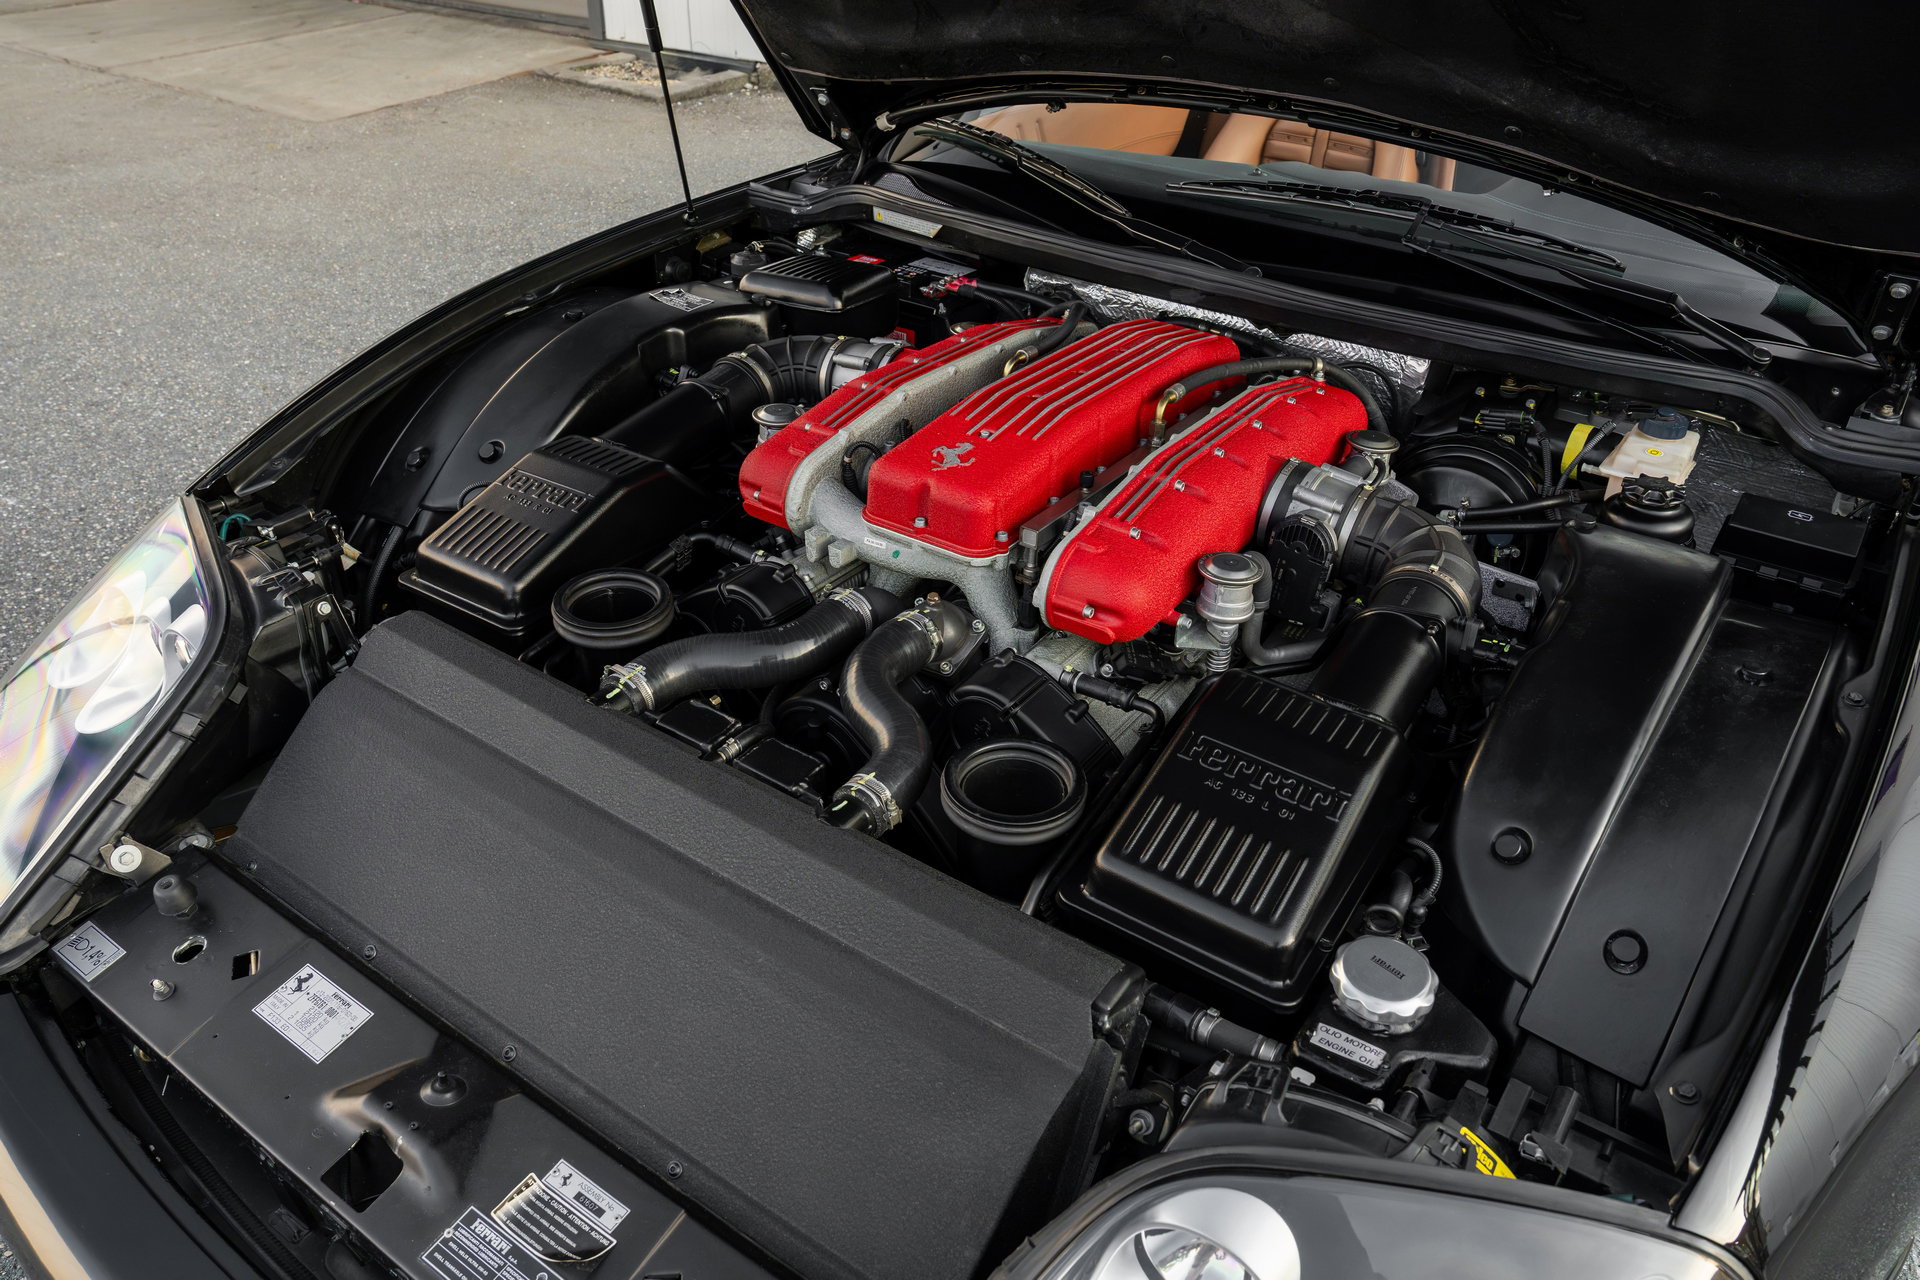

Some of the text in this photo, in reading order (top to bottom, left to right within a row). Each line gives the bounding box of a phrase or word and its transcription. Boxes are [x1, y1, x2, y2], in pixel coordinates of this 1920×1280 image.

[495, 468, 594, 513] Ferrari
[1177, 731, 1352, 822] Ferrari
[1204, 778, 1223, 790] AC
[1231, 788, 1255, 803] 133
[1278, 808, 1296, 820] 01
[1370, 955, 1406, 980] Ferrari
[331, 992, 352, 1008] Ferrari
[1318, 1037, 1375, 1066] ENGINE OIL
[1319, 1025, 1384, 1057] OLIO MOTORE
[578, 1181, 605, 1203] ASSEMBLY
[469, 1218, 513, 1254] Ferrari
